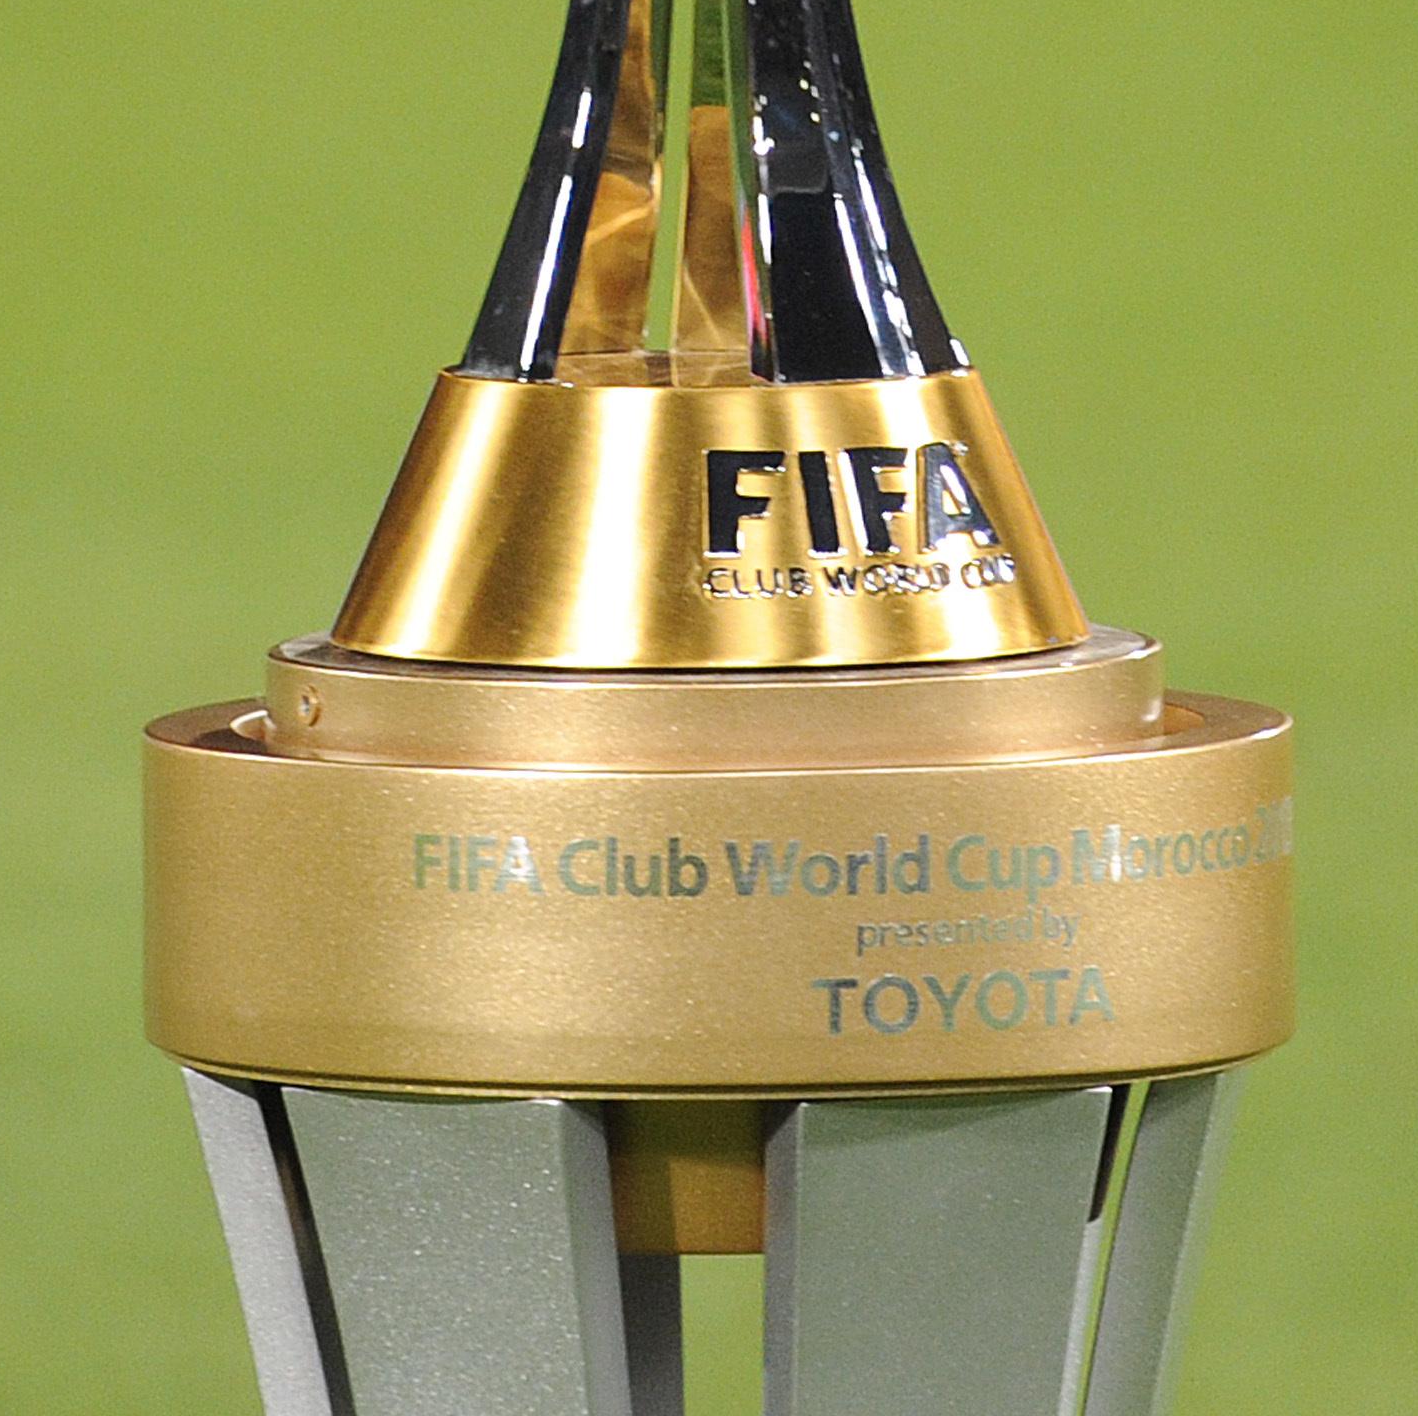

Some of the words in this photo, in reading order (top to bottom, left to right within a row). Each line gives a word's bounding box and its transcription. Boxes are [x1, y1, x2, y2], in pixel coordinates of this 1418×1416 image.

[703, 442, 1001, 558] FIFA
[703, 566, 814, 599] CLUB
[414, 833, 544, 893] FIFA
[558, 837, 708, 897] Club
[724, 832, 931, 896] World
[947, 835, 1062, 904] Cup
[1071, 824, 1250, 883] Morocco
[856, 906, 1036, 955] presented
[1042, 908, 1079, 947] by
[812, 966, 1114, 1033] TOYOTA
